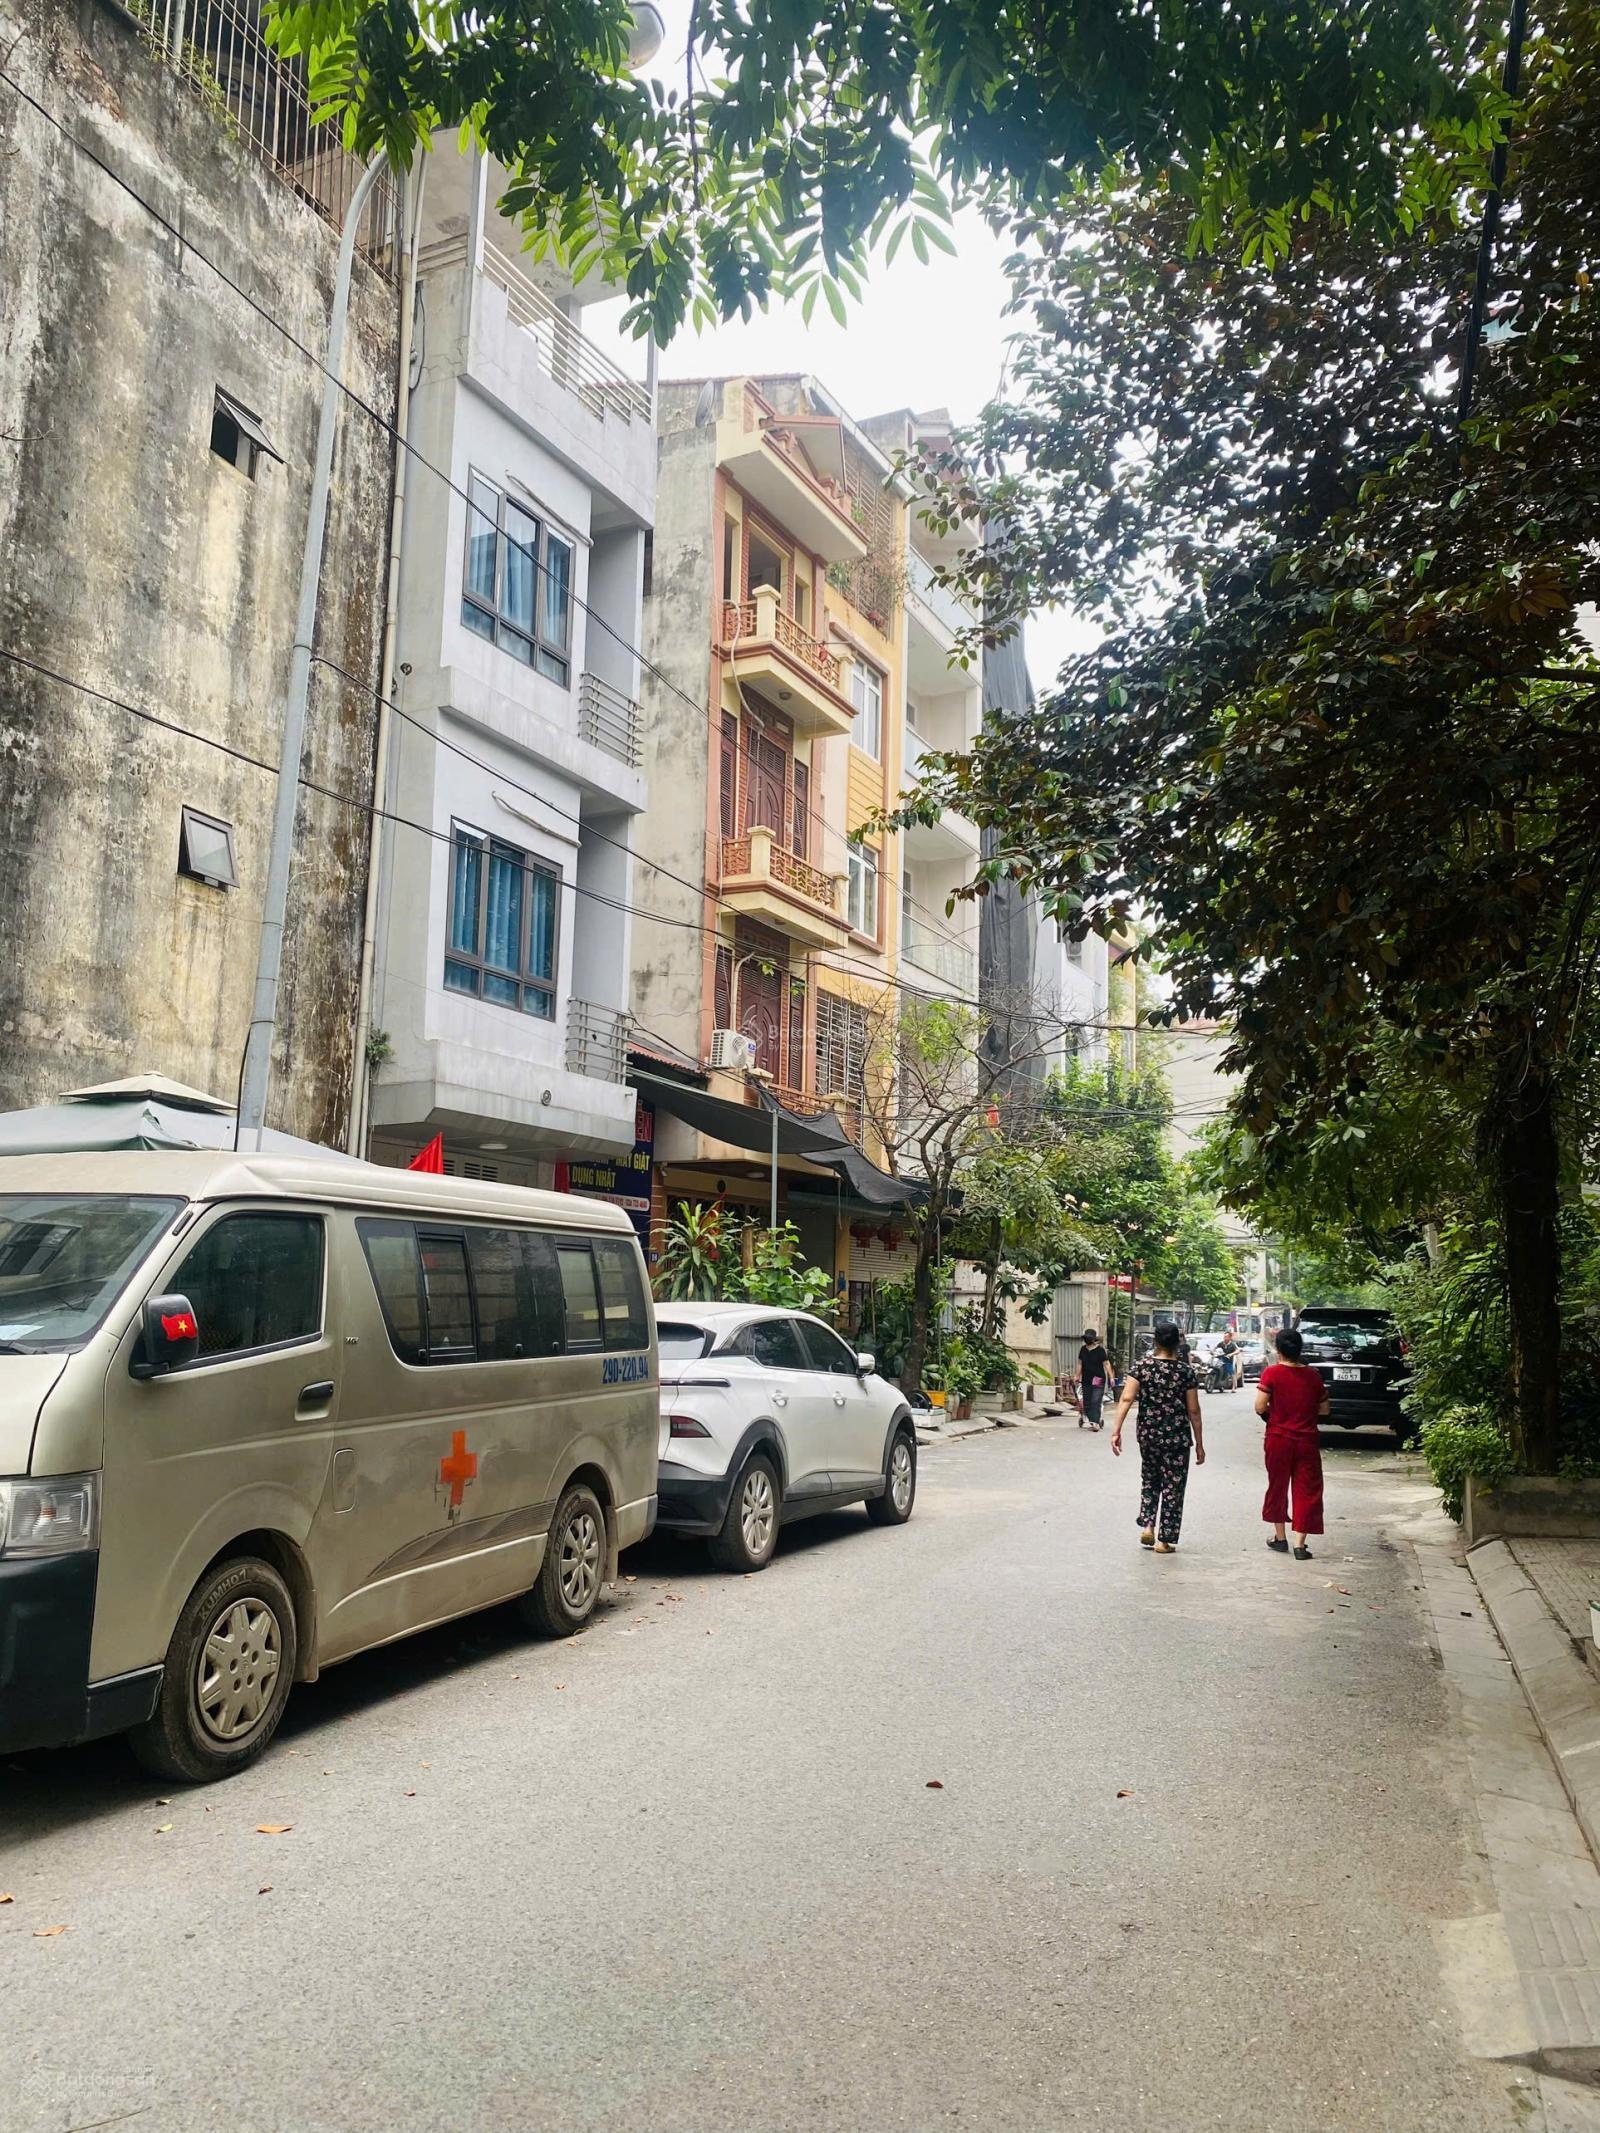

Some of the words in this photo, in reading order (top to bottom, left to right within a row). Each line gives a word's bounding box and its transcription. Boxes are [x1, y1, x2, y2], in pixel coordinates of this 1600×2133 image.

[633, 1151, 651, 1174] GIẬT
[572, 1166, 595, 1187] DỤNG
[595, 1168, 616, 1191] NHẬT
